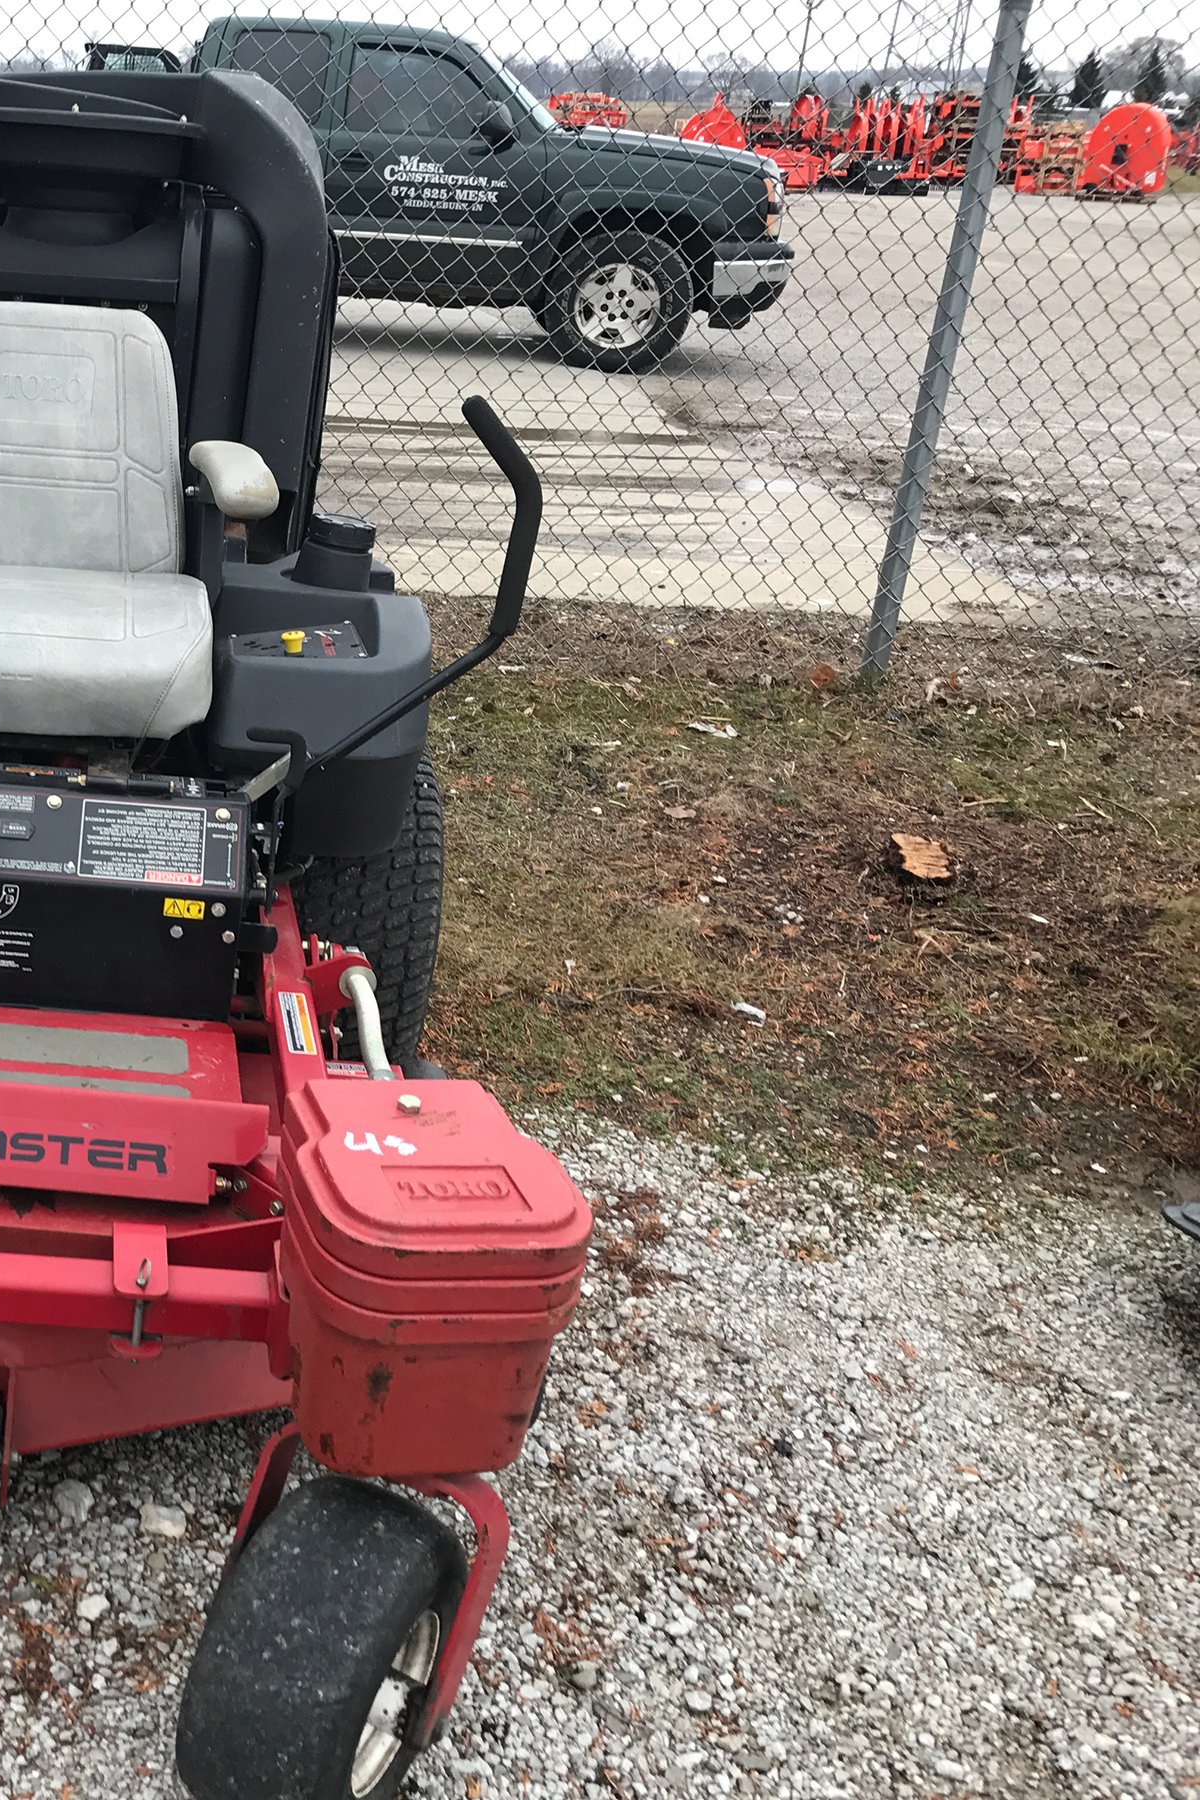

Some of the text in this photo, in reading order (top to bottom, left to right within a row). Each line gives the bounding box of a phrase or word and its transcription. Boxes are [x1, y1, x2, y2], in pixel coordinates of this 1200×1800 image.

[399, 155, 445, 174] MESK
[1, 373, 86, 404] TORO
[148, 872, 188, 883] DANGER
[397, 1181, 511, 1201] TORO
